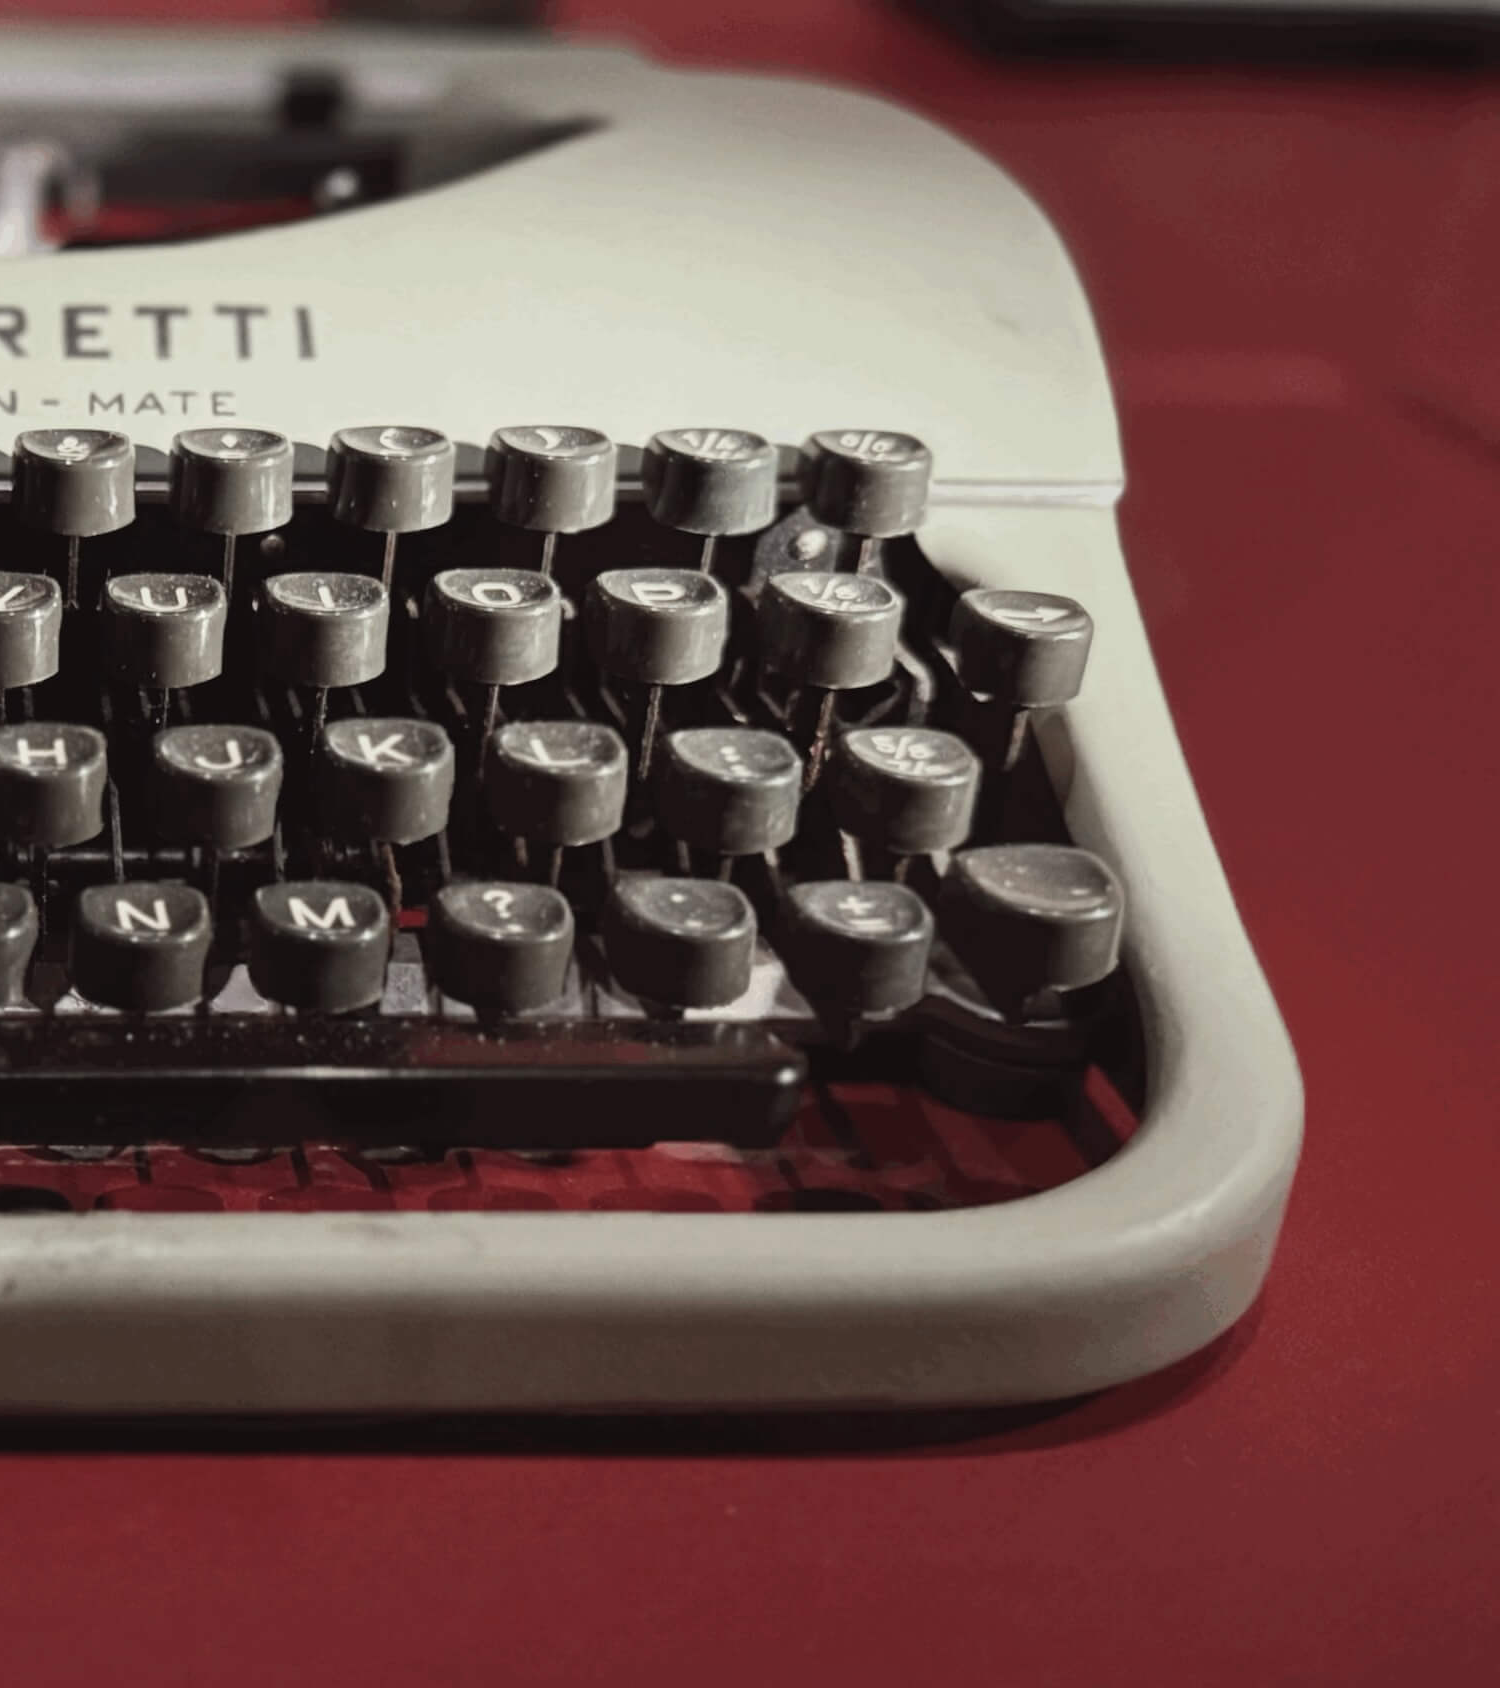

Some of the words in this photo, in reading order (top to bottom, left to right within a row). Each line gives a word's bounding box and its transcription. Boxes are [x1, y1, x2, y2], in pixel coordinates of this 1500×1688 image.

[88, 392, 238, 417] MATE
[140, 587, 188, 611] U
[471, 582, 523, 605] O
[17, 739, 67, 765] H
[195, 739, 244, 770] J
[358, 734, 413, 765] K
[530, 739, 591, 766] L
[115, 899, 172, 931] N
[288, 897, 355, 928] M
